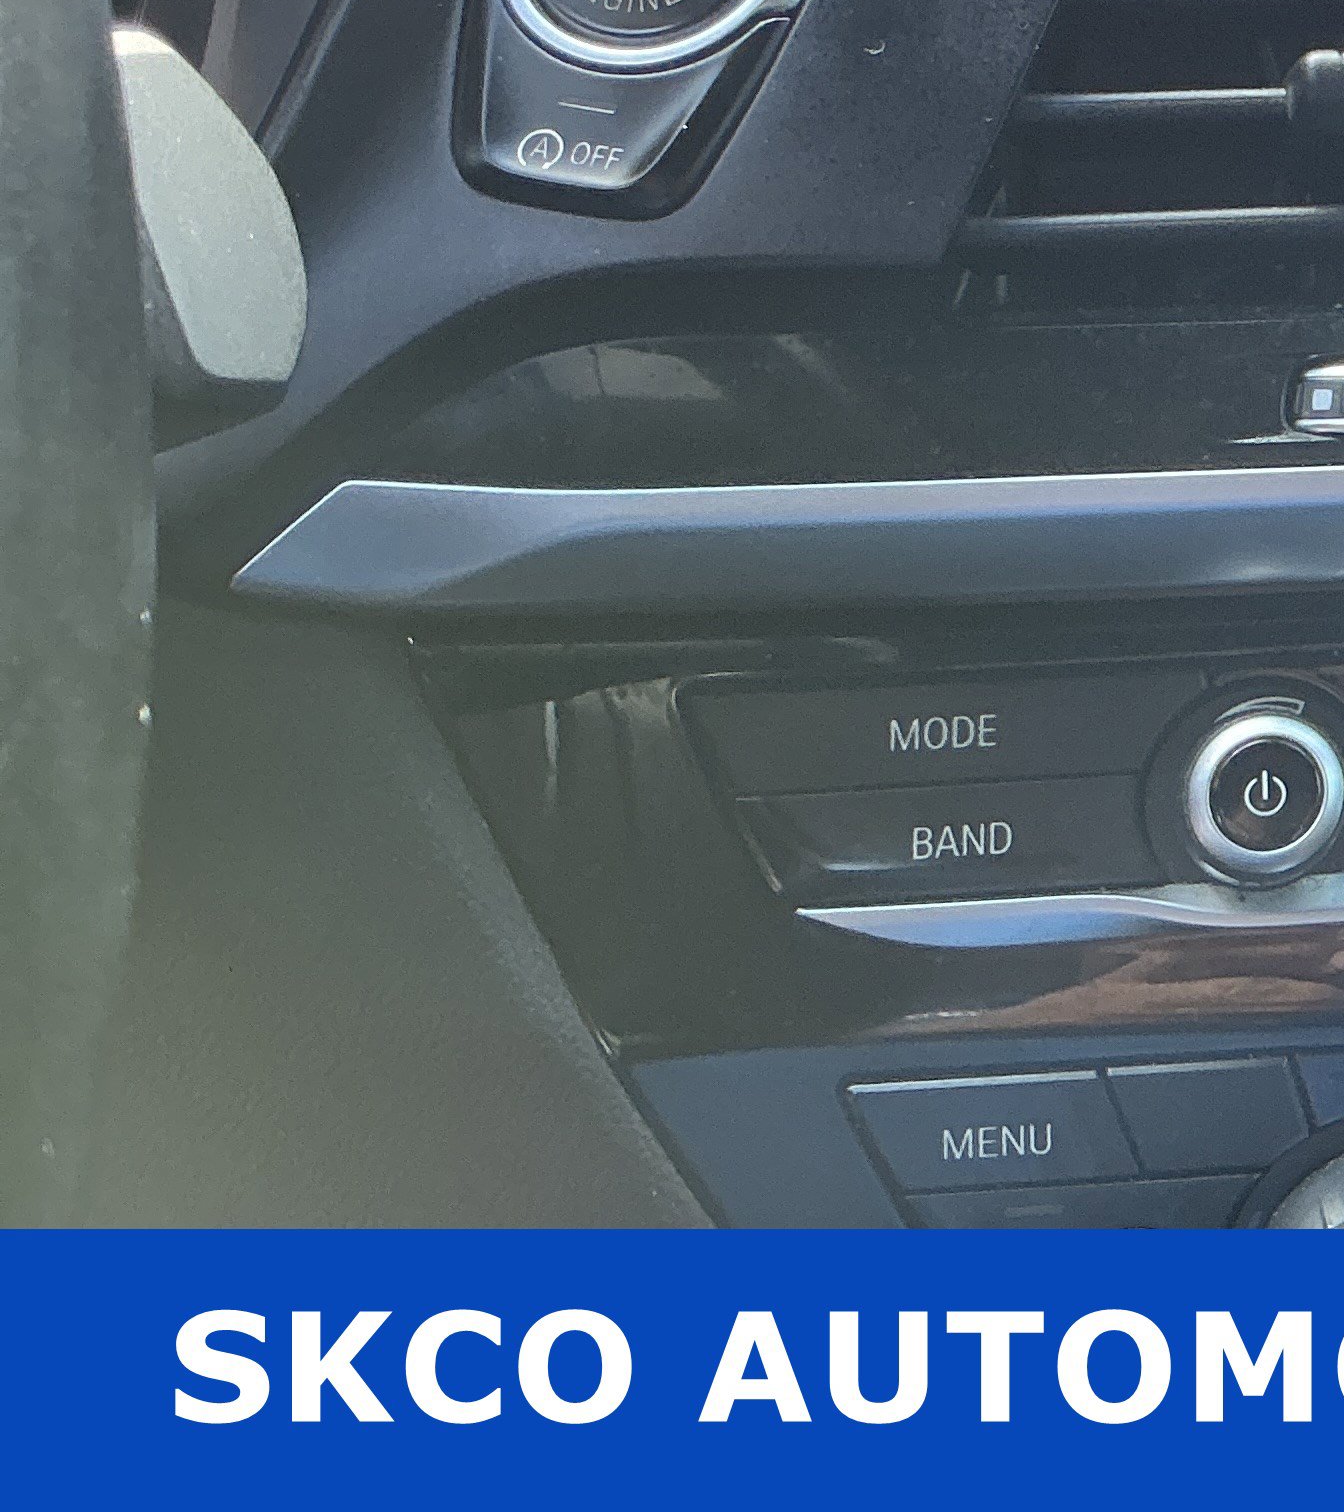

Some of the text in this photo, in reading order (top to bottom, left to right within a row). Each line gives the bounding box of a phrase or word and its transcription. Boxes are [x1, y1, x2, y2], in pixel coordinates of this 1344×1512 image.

[571, 141, 624, 170] OFF
[889, 714, 997, 752] MODE
[912, 822, 1013, 860] BAND
[942, 1123, 1053, 1160] MENU
